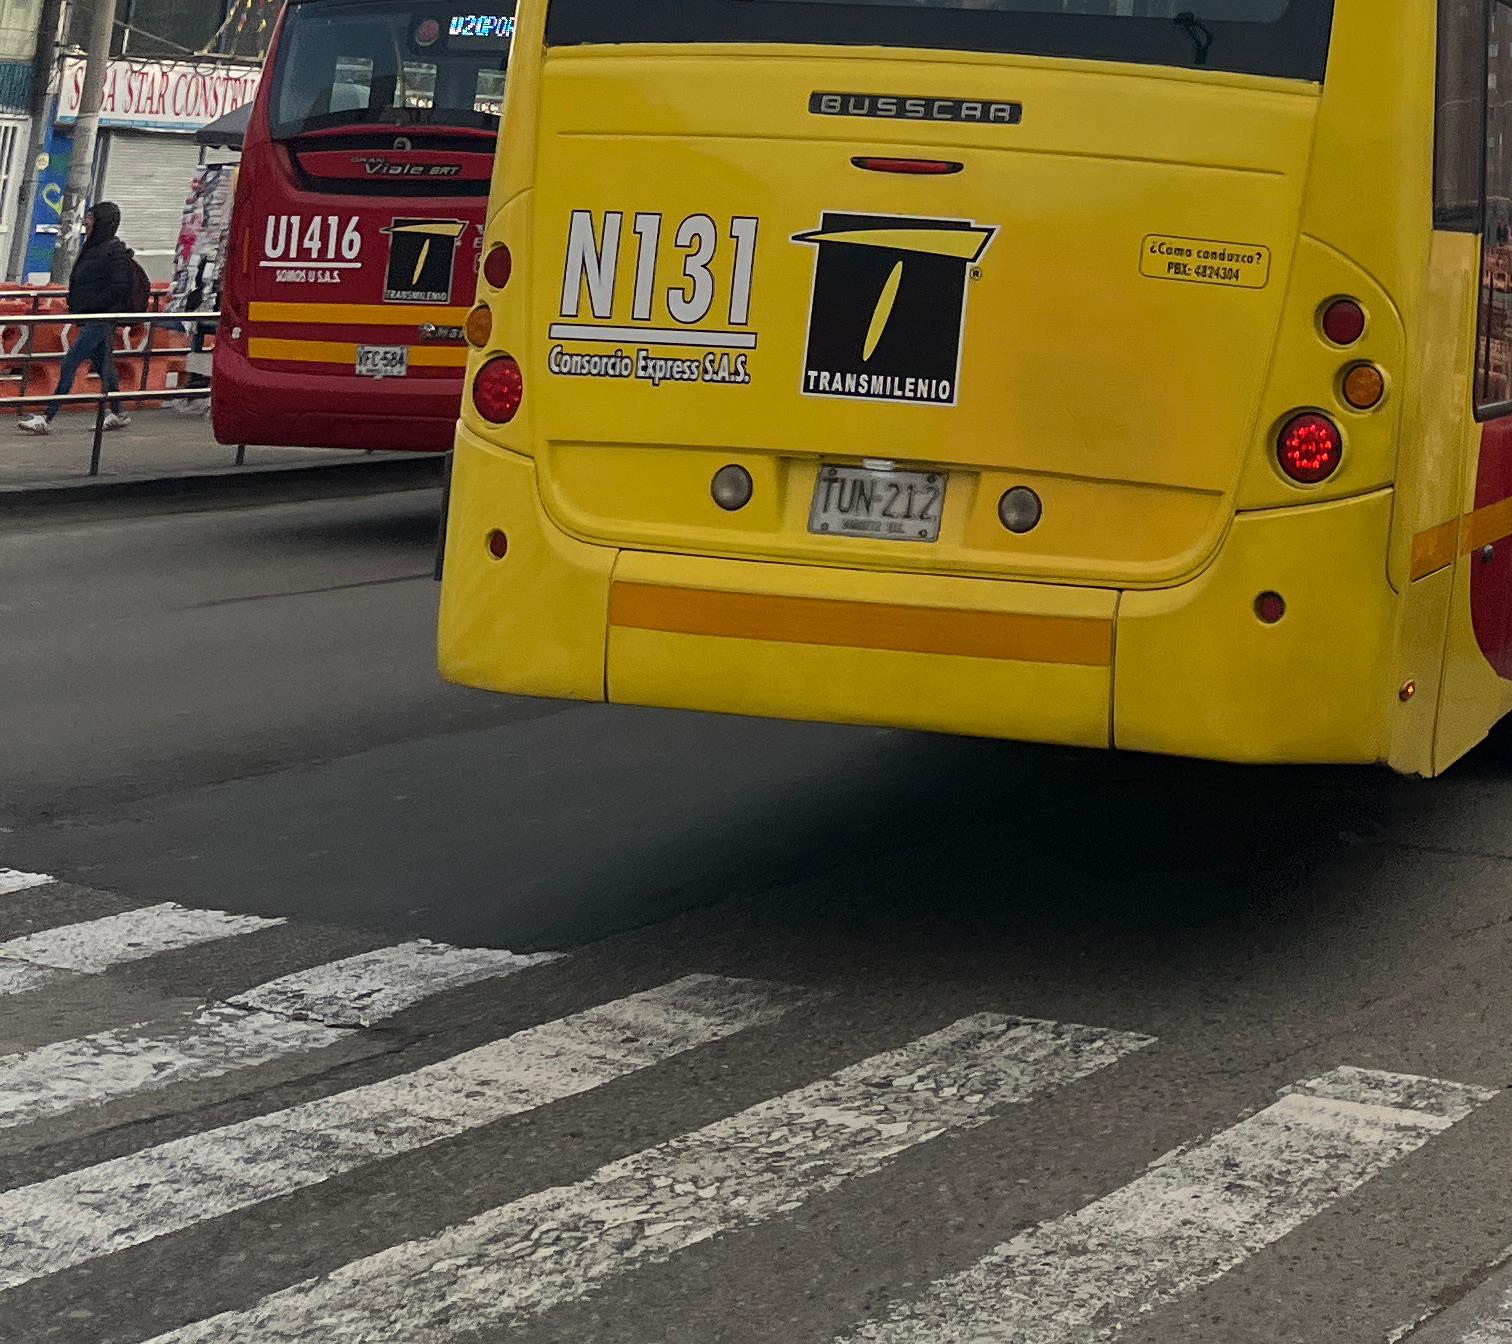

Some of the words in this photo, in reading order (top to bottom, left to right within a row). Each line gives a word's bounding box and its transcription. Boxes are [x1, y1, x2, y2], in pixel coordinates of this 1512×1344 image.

[125, 70, 169, 115] STAR
[820, 95, 1012, 122] BUSSCAR
[365, 163, 424, 175] Viale
[264, 215, 362, 260] U1416
[559, 209, 759, 326] N131
[549, 344, 633, 378] Consorcio
[635, 348, 701, 387] Express
[702, 352, 751, 384] S.A.S.
[806, 370, 951, 400] TRANSMILENIO
[823, 477, 940, 520] TUN-212
